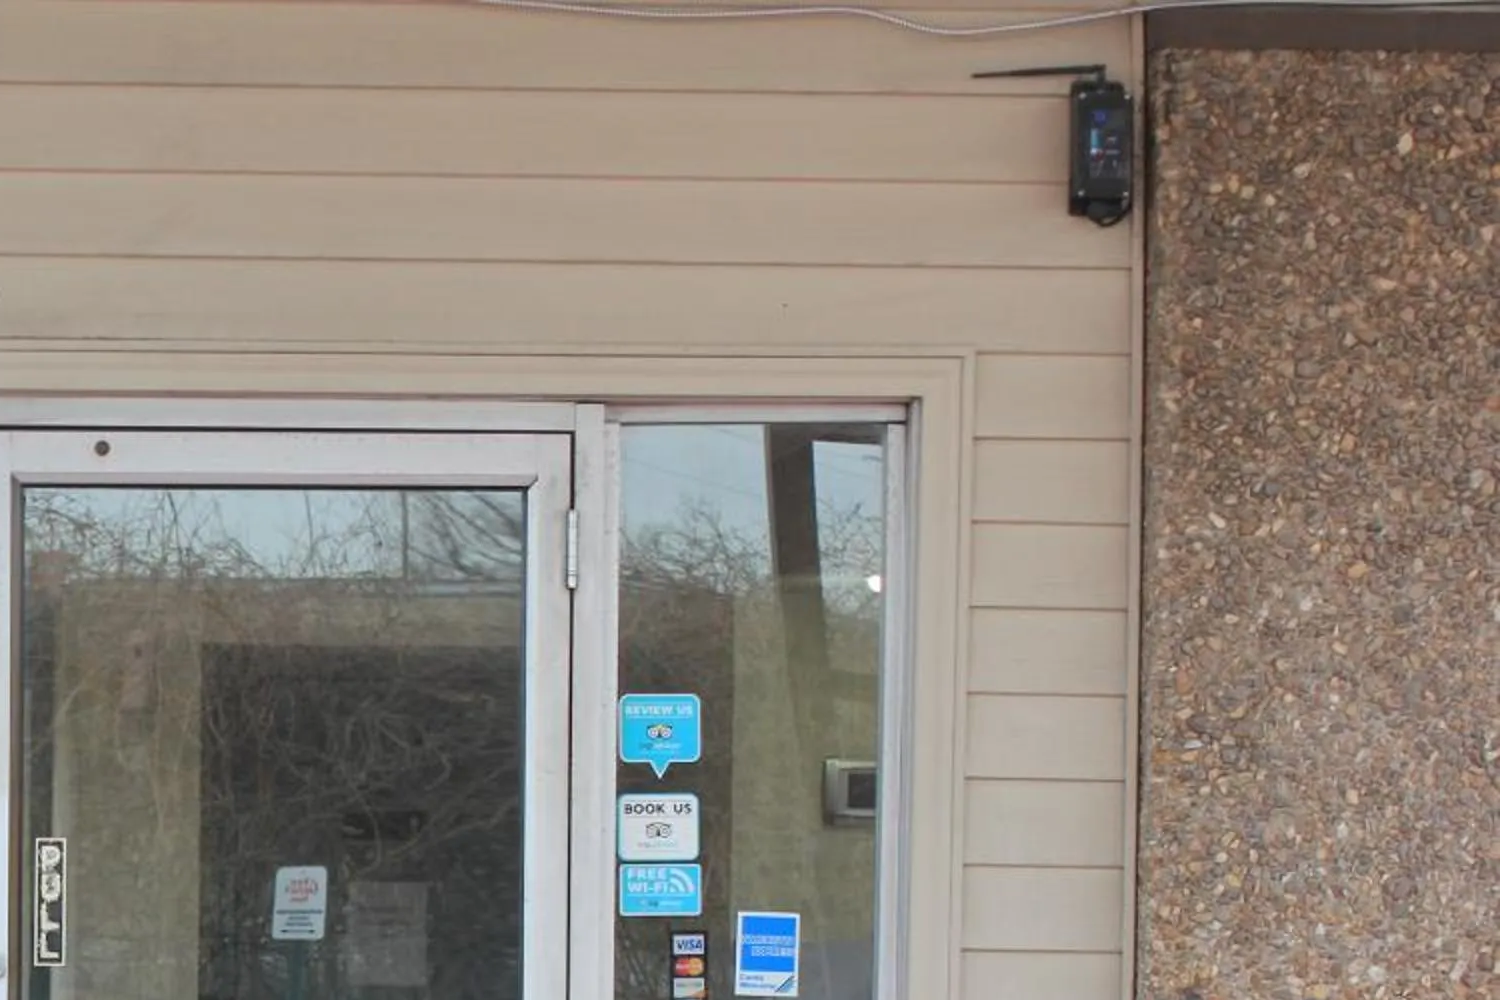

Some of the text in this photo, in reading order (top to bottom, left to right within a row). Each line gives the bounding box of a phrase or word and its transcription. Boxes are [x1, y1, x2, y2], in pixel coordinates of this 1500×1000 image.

[625, 704, 693, 716] REVIEW US
[624, 803, 693, 815] BOOK US
[627, 867, 667, 880] FREE
[627, 881, 668, 893] WI-FI
[677, 939, 703, 951] VISA
